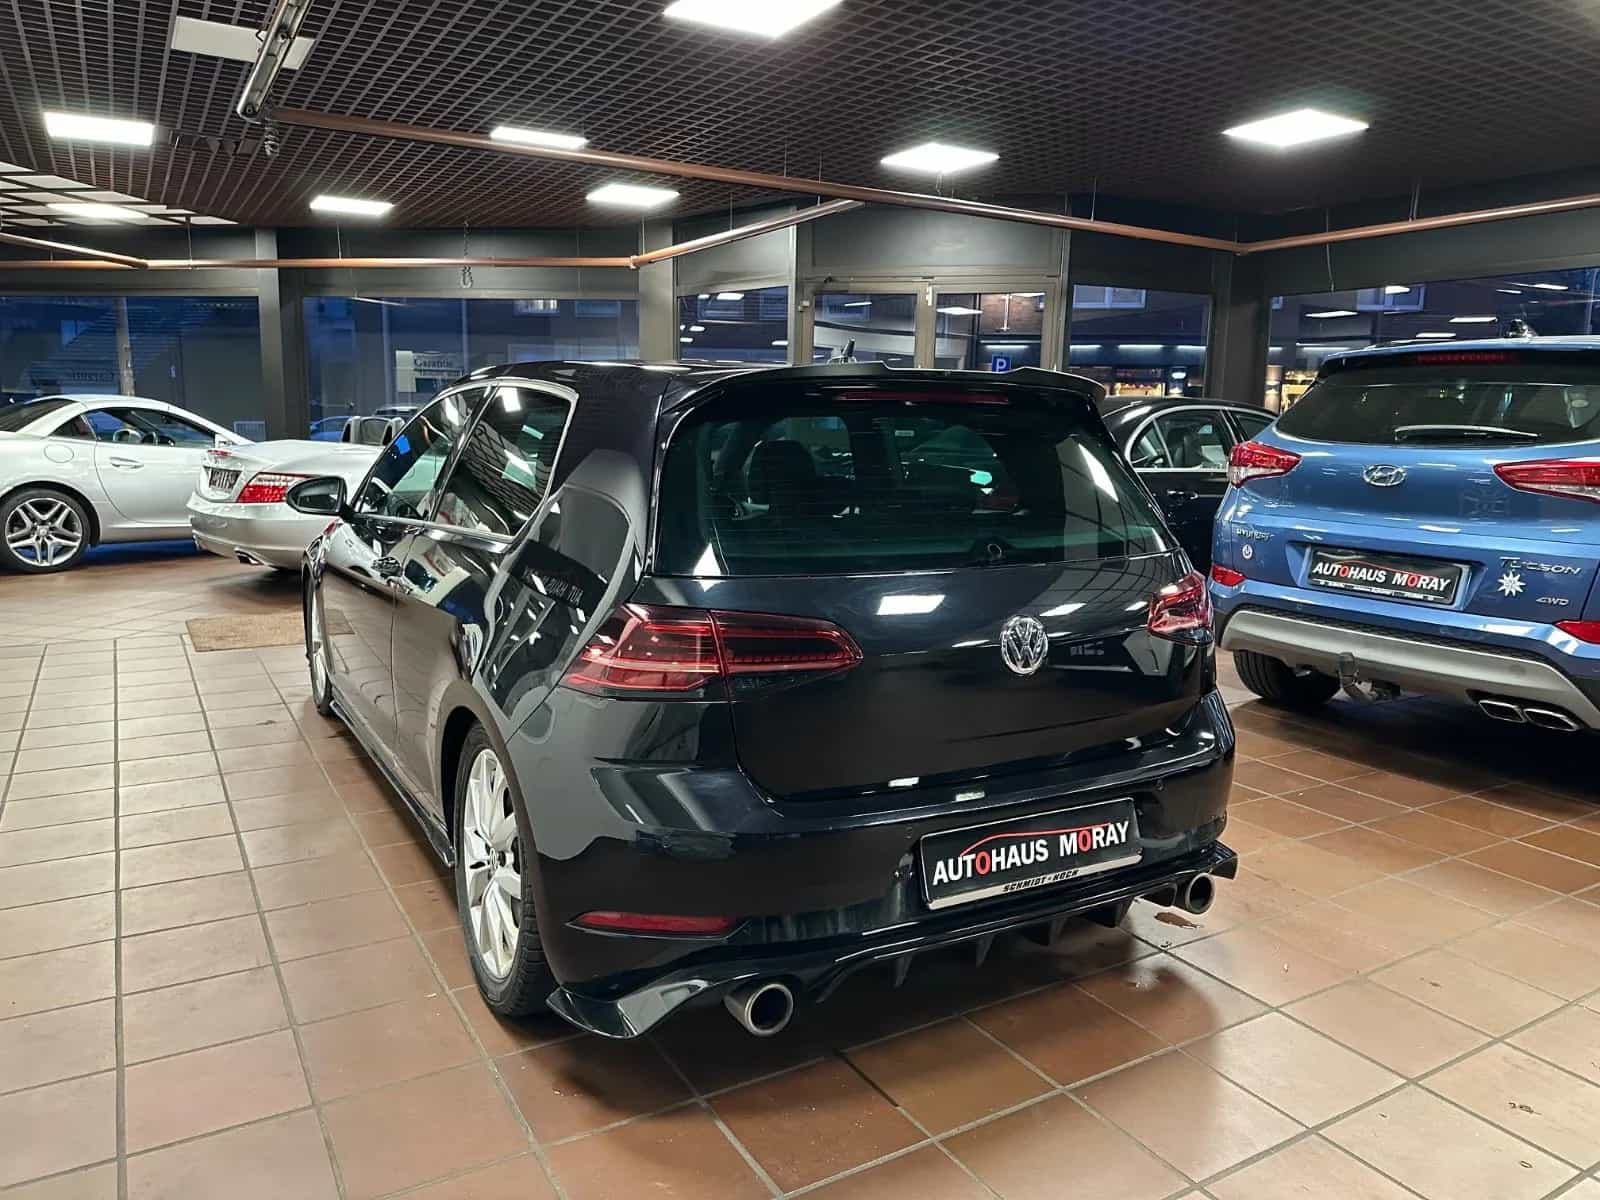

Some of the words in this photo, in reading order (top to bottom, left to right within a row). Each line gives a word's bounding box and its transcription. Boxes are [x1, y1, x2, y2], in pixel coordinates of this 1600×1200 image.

[996, 358, 1007, 372] P
[1312, 562, 1387, 583] AUTOHAUS
[1392, 572, 1451, 592] MORAY
[1536, 596, 1569, 606] 4WD
[932, 840, 1049, 886] AUTOHAUS
[1060, 820, 1129, 857] MORAY
